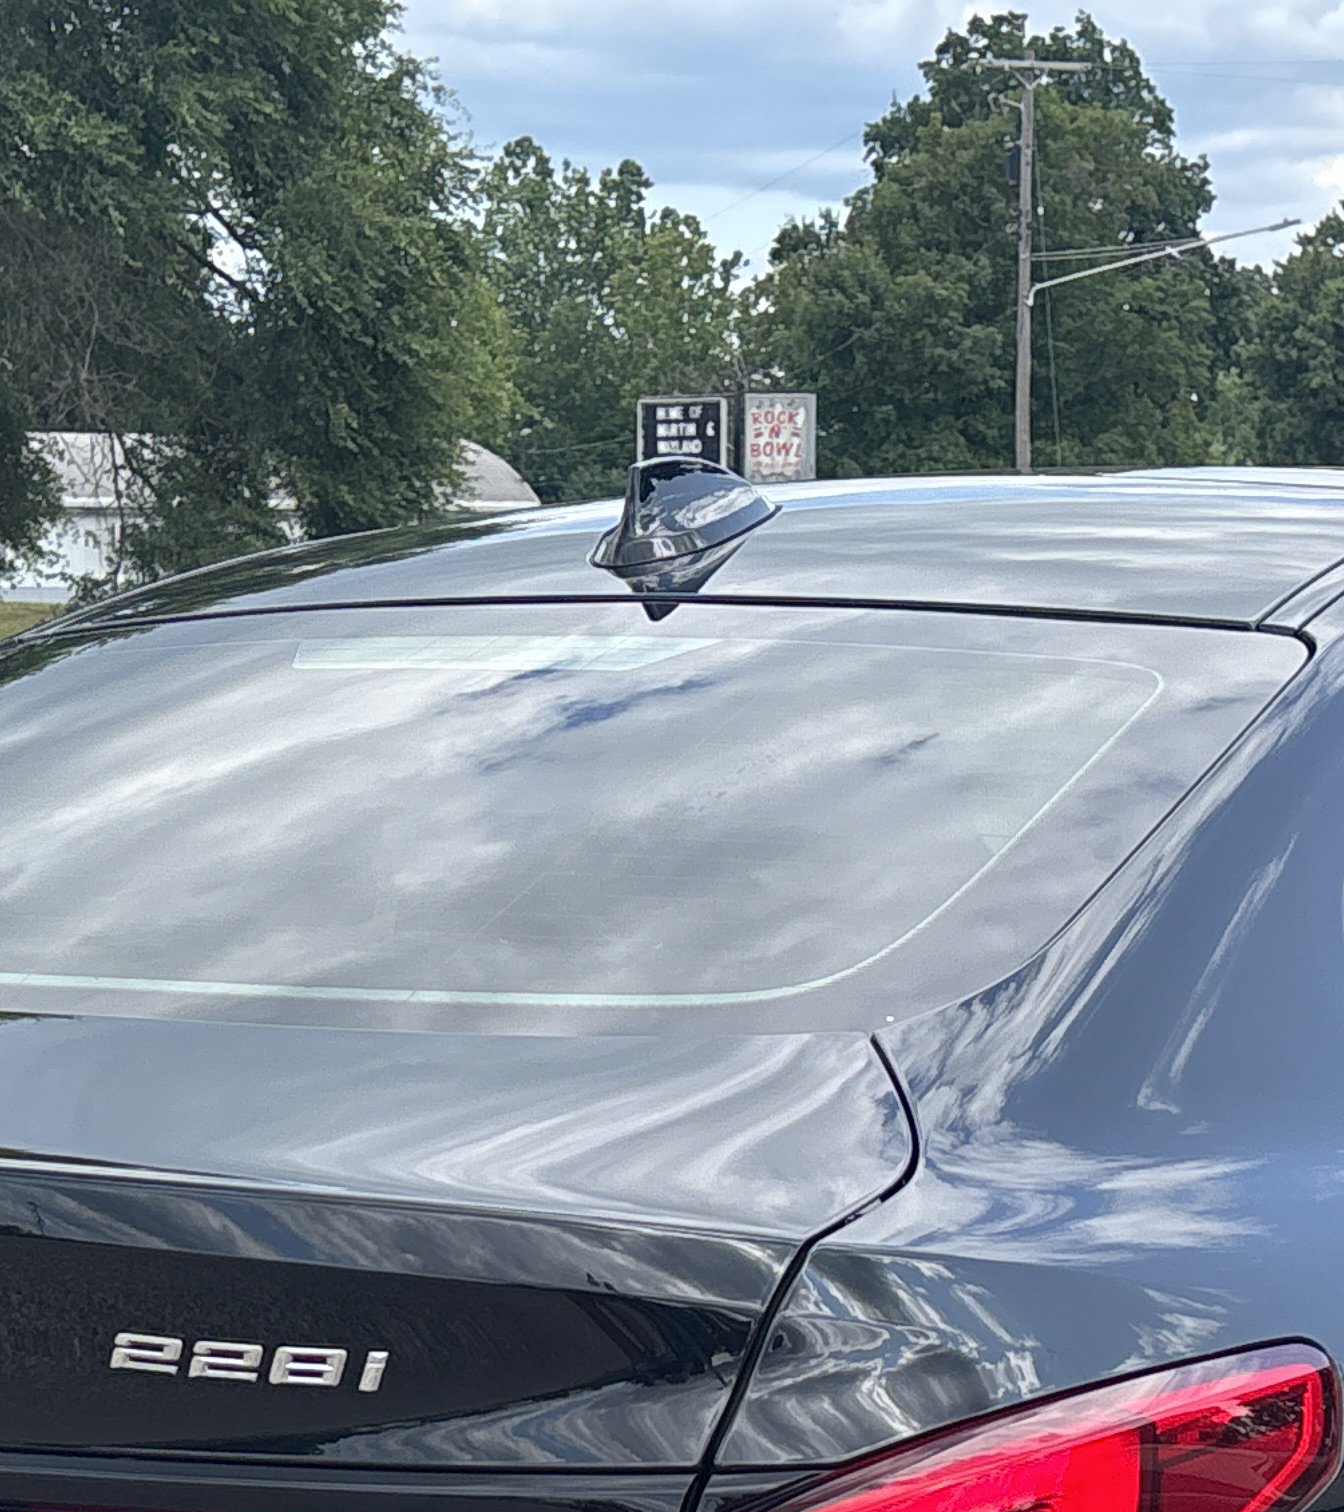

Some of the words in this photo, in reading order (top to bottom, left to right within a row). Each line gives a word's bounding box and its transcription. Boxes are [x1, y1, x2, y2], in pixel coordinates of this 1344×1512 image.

[750, 410, 800, 425] ROCK
[750, 440, 803, 458] BOWL
[110, 1332, 389, 1392] 228i
